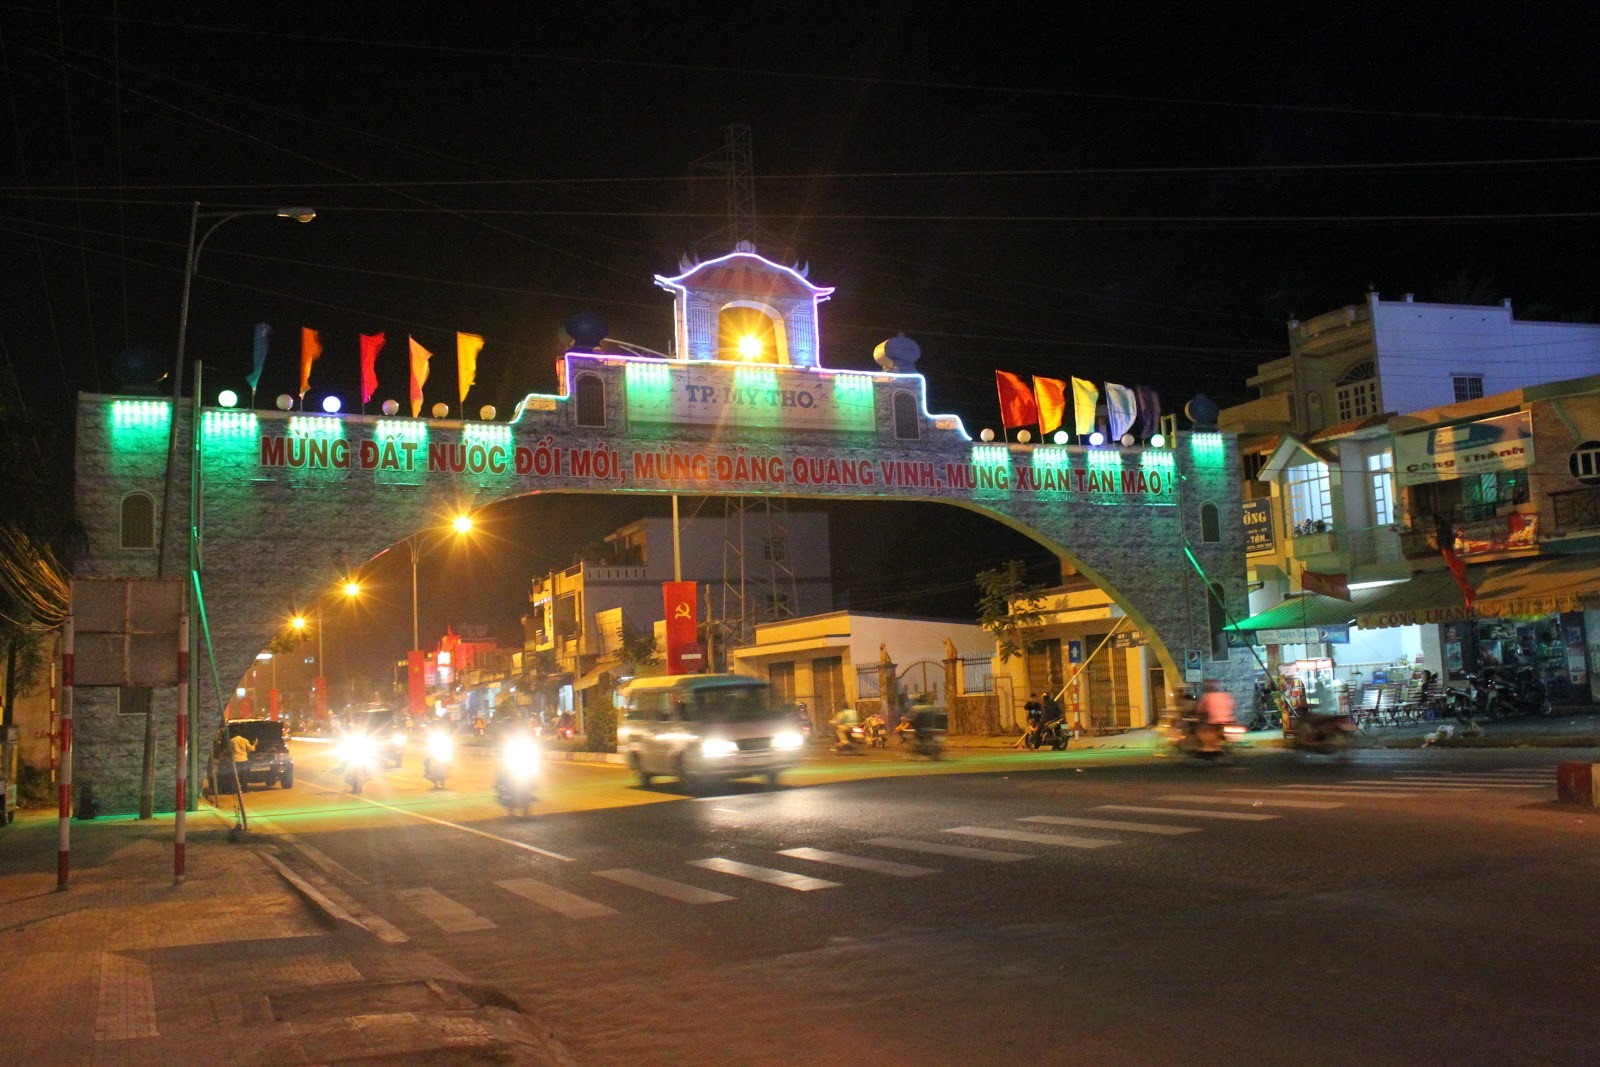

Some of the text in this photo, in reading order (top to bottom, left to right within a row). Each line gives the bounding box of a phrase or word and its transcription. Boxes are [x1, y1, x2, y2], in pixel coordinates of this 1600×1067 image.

[686, 384, 717, 404] TP.
[261, 430, 350, 469] MỪNG
[360, 433, 418, 471] ĐẤT
[428, 437, 506, 474] NƯỚC
[514, 435, 562, 477] ĐỔI
[570, 442, 627, 484] MỚI,
[634, 447, 709, 481] MỪNG
[716, 446, 785, 484] ĐẢNG
[792, 455, 874, 486] QUANG
[881, 460, 942, 492] VINH,
[946, 457, 1009, 490] MỪNG
[1015, 462, 1071, 492] XUÂN
[1074, 465, 1116, 493] TÂN
